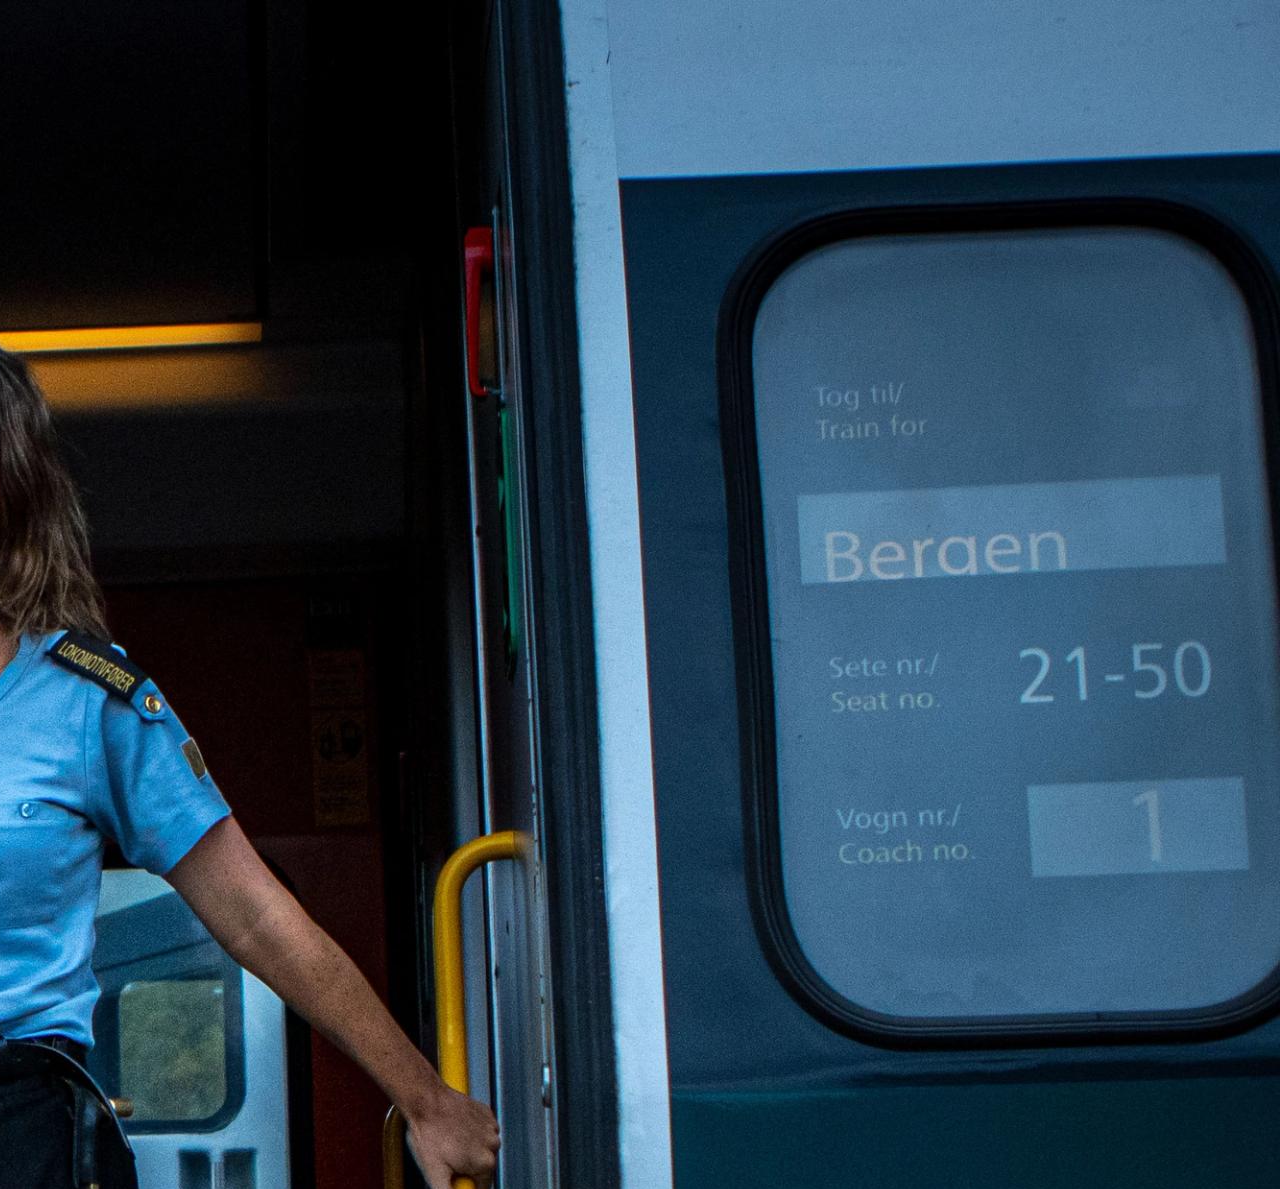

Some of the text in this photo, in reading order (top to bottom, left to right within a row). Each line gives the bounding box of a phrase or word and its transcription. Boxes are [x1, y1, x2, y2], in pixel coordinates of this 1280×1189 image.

[817, 386, 860, 412] Tog
[817, 414, 928, 440] Train for
[57, 640, 136, 694] LOKOMOTIVFØRER
[828, 652, 940, 679] Sete nr./
[1018, 640, 1213, 704] 21-50
[831, 689, 941, 713] Seat no.
[836, 803, 963, 835] Vogn nr./
[1132, 789, 1163, 862] 1
[838, 840, 977, 865] Coach no.
